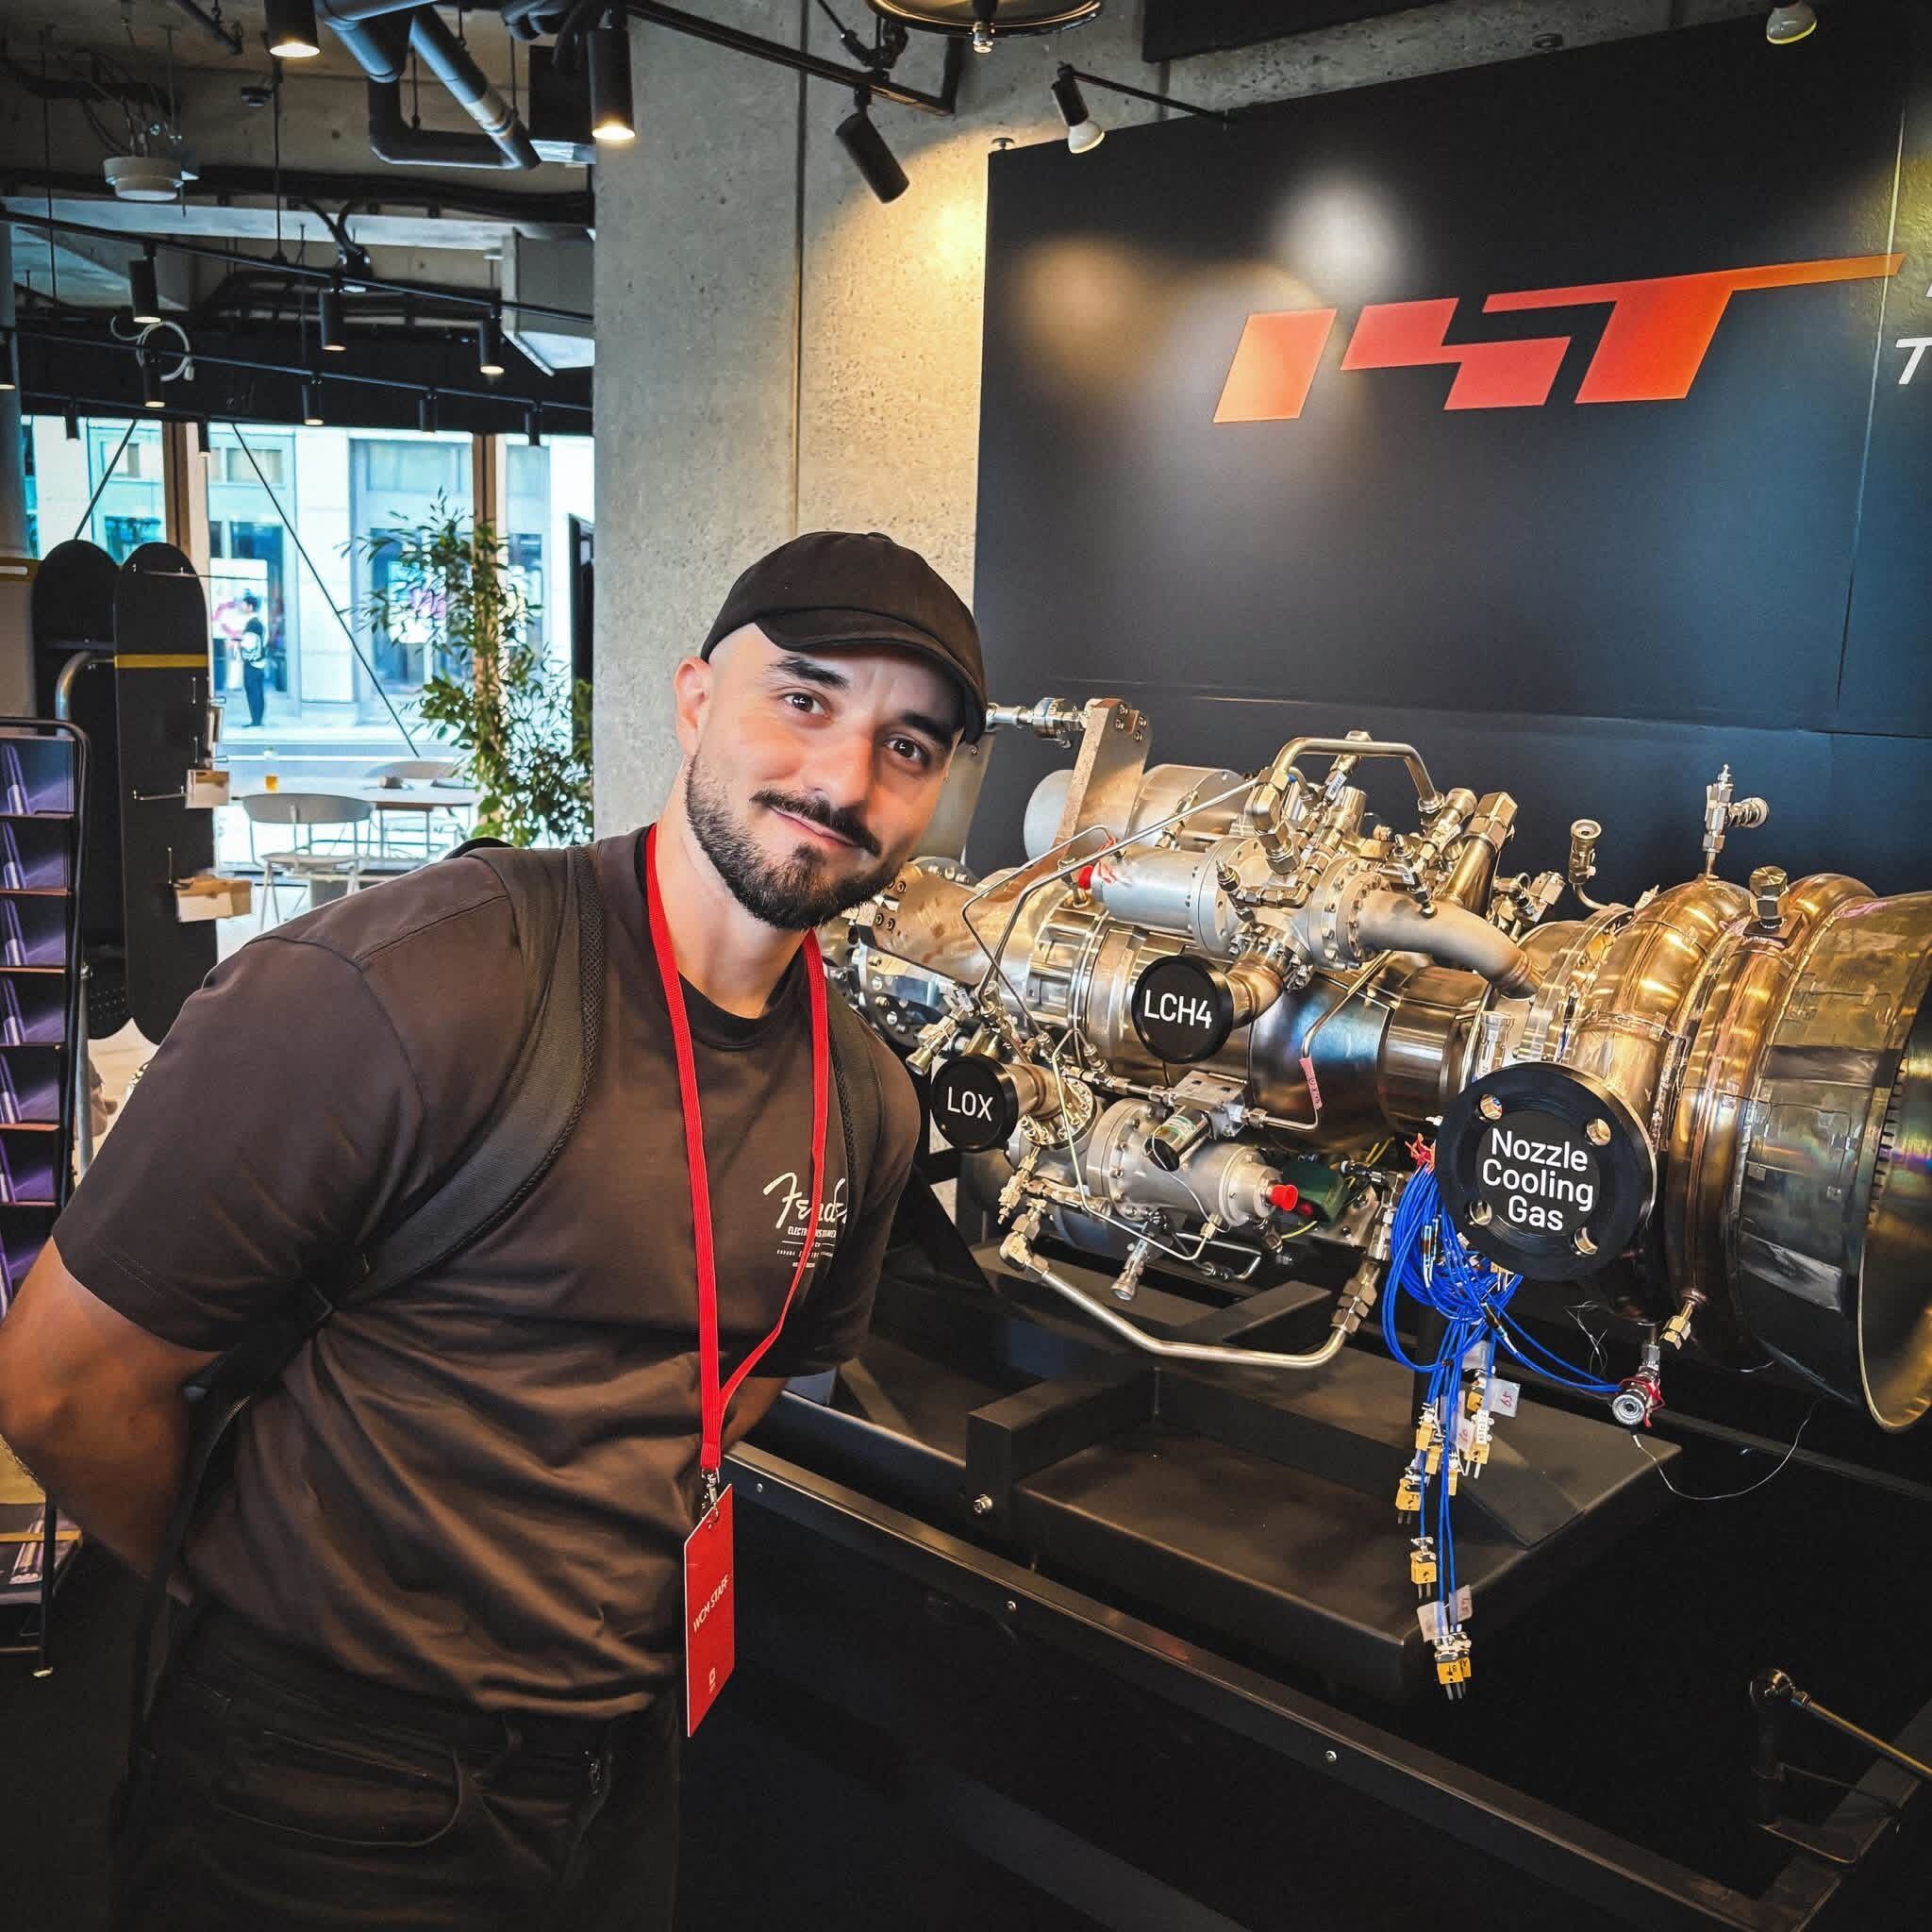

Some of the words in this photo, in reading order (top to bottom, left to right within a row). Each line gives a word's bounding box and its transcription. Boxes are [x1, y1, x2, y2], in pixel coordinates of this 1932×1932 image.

[1143, 989, 1212, 1029] LCH4
[947, 1086, 993, 1122] LOX
[1491, 1127, 1589, 1172] Nozzle
[1482, 1158, 1593, 1212] Cooling
[1507, 1194, 1563, 1231] Gas
[709, 1574, 729, 1608] STAFF
